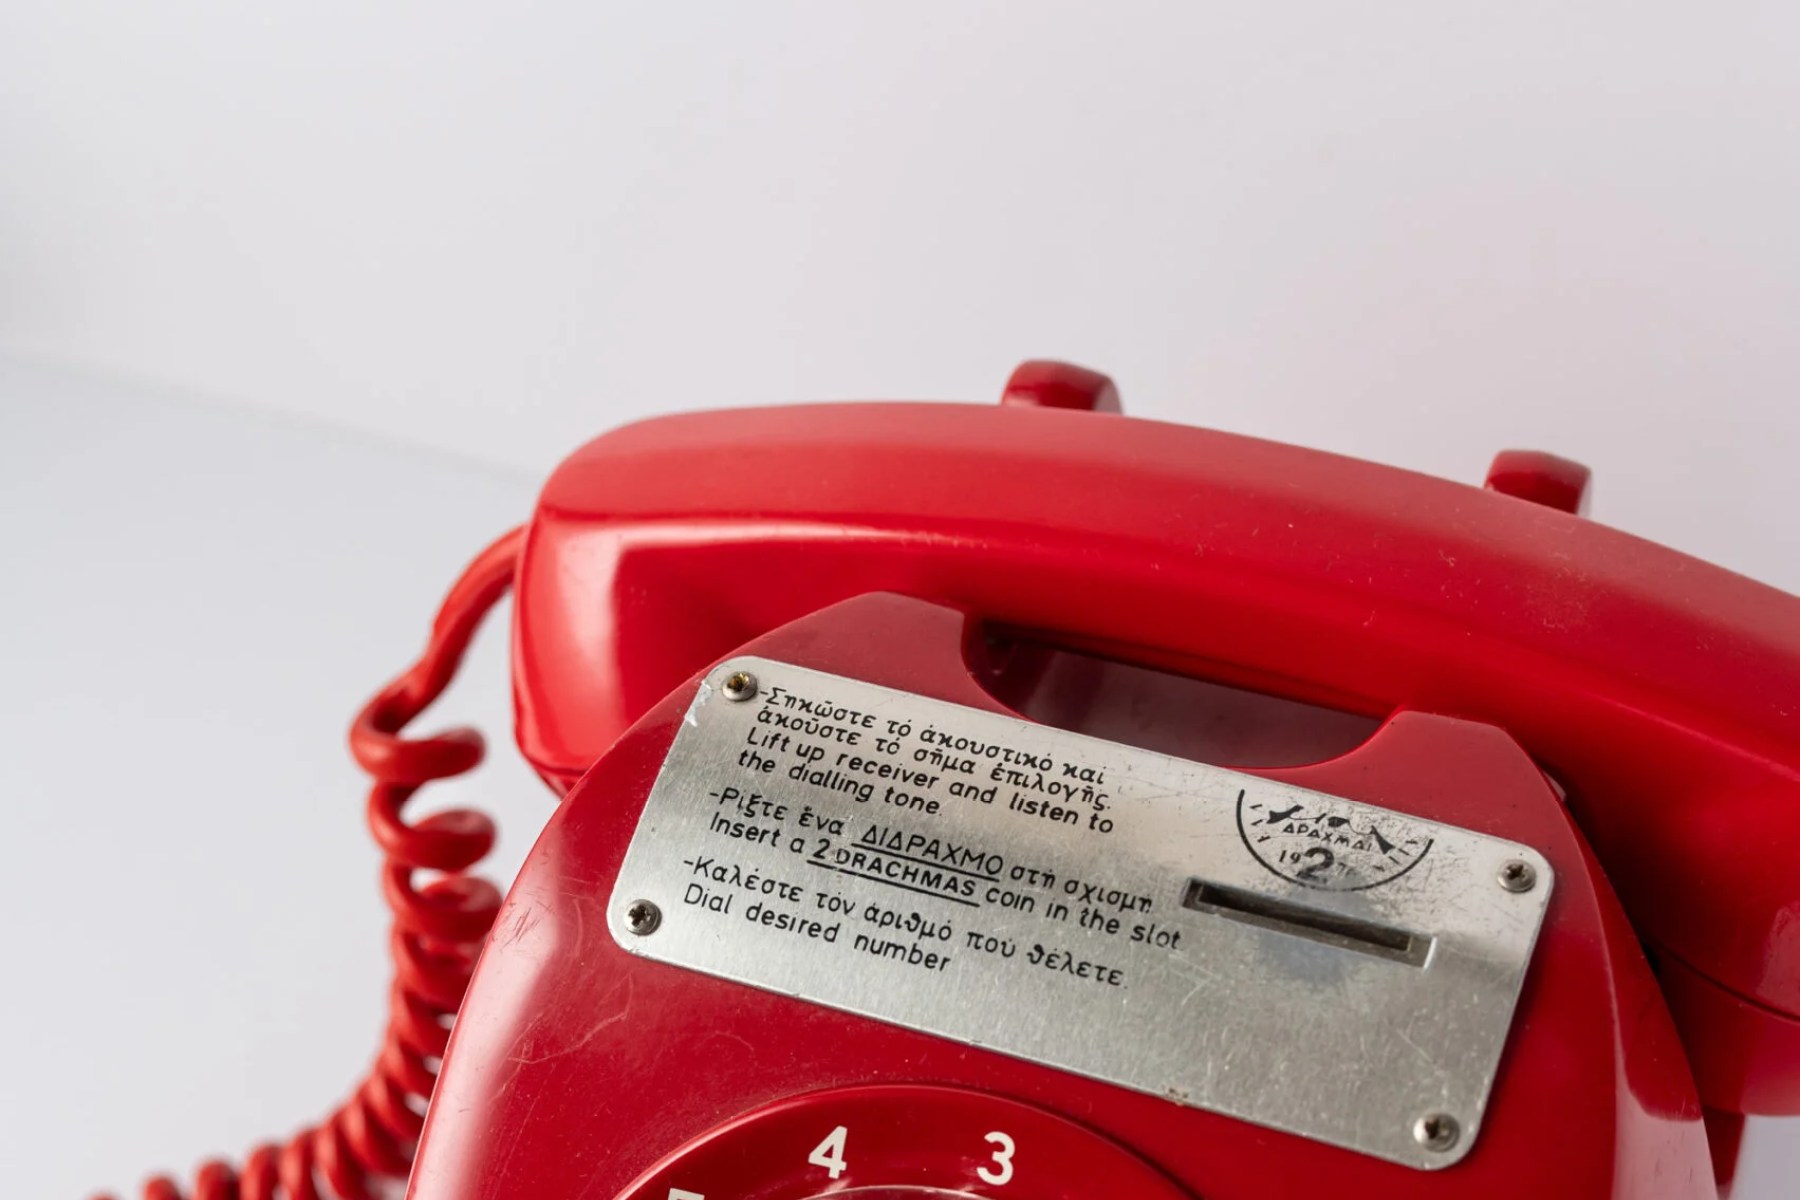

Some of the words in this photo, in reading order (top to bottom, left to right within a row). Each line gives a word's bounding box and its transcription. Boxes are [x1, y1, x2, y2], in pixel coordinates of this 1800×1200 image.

[738, 749, 776, 773] the
[788, 763, 875, 803] dialling
[884, 786, 942, 816] tone.
[747, 726, 790, 752] Lift
[796, 744, 825, 764] up
[836, 752, 940, 789] receiver
[949, 781, 998, 804] and
[1009, 792, 1079, 825] listen
[1088, 813, 1114, 834] to
[710, 811, 781, 847] Insert
[789, 837, 806, 853] a
[812, 838, 831, 860] 2
[835, 848, 977, 897] DRACHMAS
[986, 887, 1035, 912] coin
[1046, 902, 1069, 921] in
[1080, 906, 1120, 934] the
[1130, 924, 1181, 949] slot
[861, 825, 1004, 875] ΔΙΔΡΑΧΜΟ
[1296, 847, 1334, 881] 2
[684, 883, 733, 914] Dial
[745, 902, 841, 943] desired
[854, 934, 951, 972] number
[809, 1126, 847, 1179] 4
[977, 1131, 1015, 1185] 3
